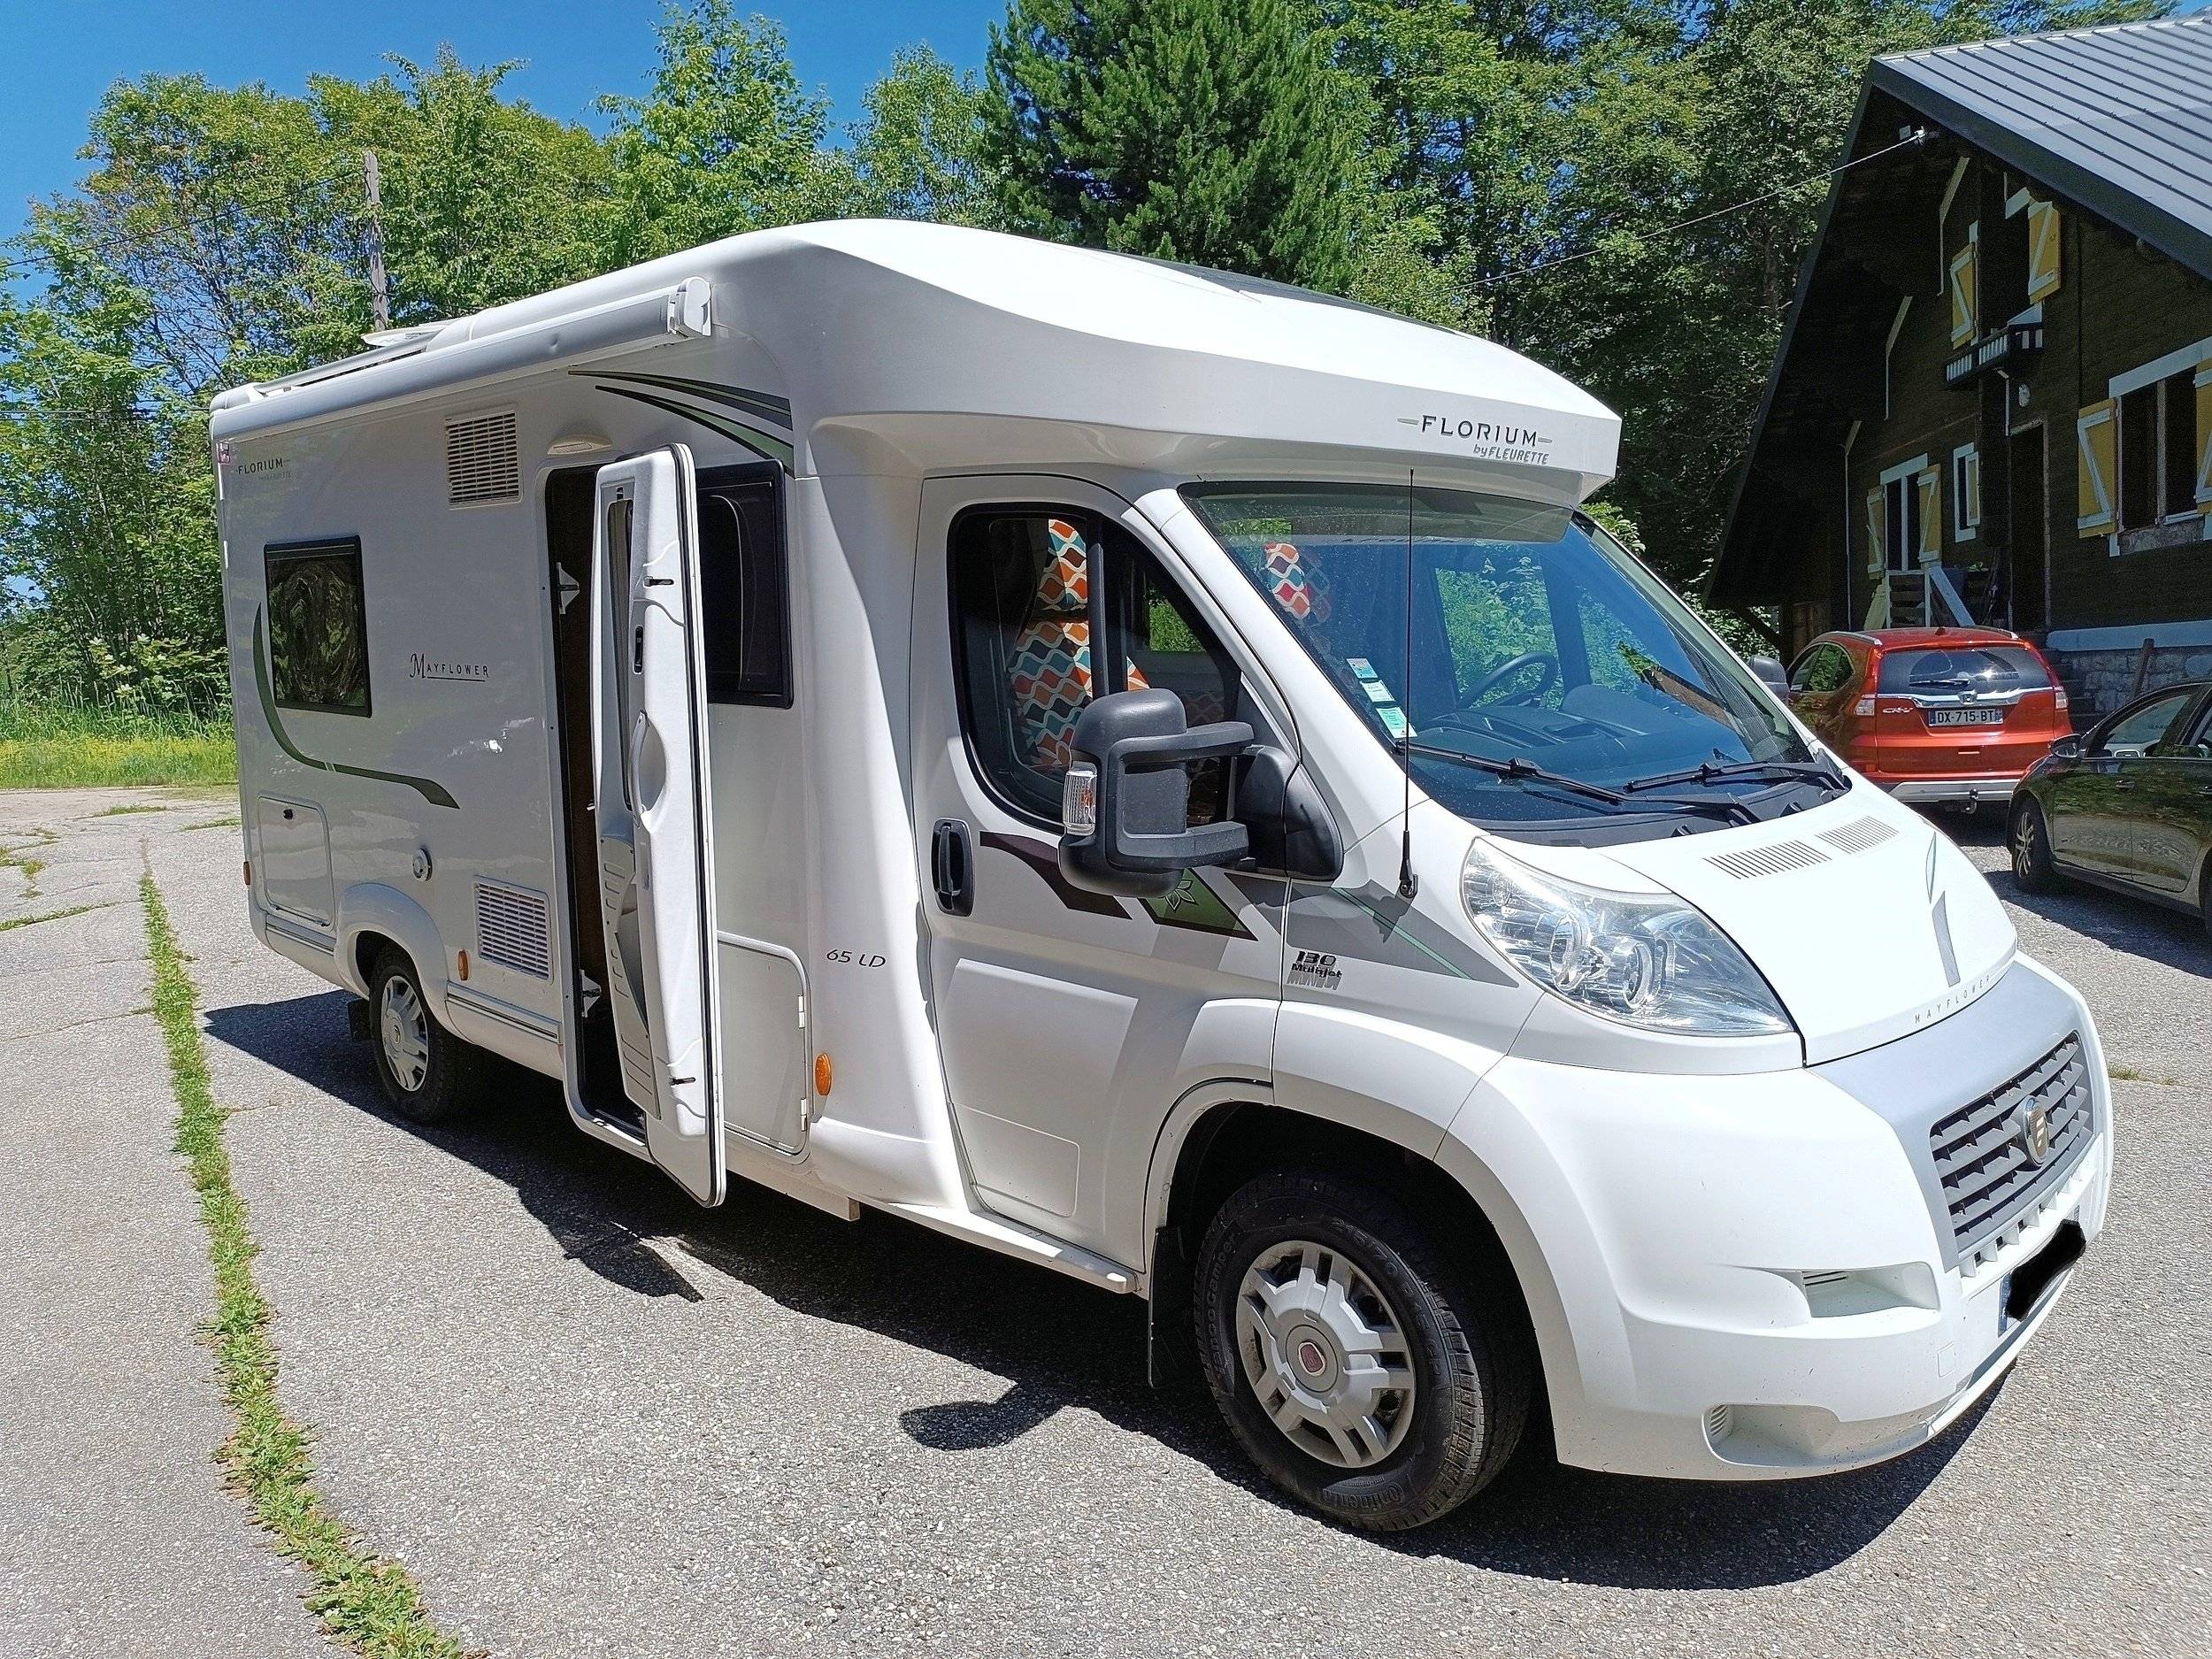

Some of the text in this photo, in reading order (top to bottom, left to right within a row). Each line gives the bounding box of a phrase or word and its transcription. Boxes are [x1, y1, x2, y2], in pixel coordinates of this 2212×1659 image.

[1421, 414, 1538, 448] FLORIUM
[237, 457, 283, 475] FLORIUM
[1937, 710, 1994, 724] DX-715-BT
[826, 949, 887, 968] 65 LD
[1295, 950, 1337, 966] 130
